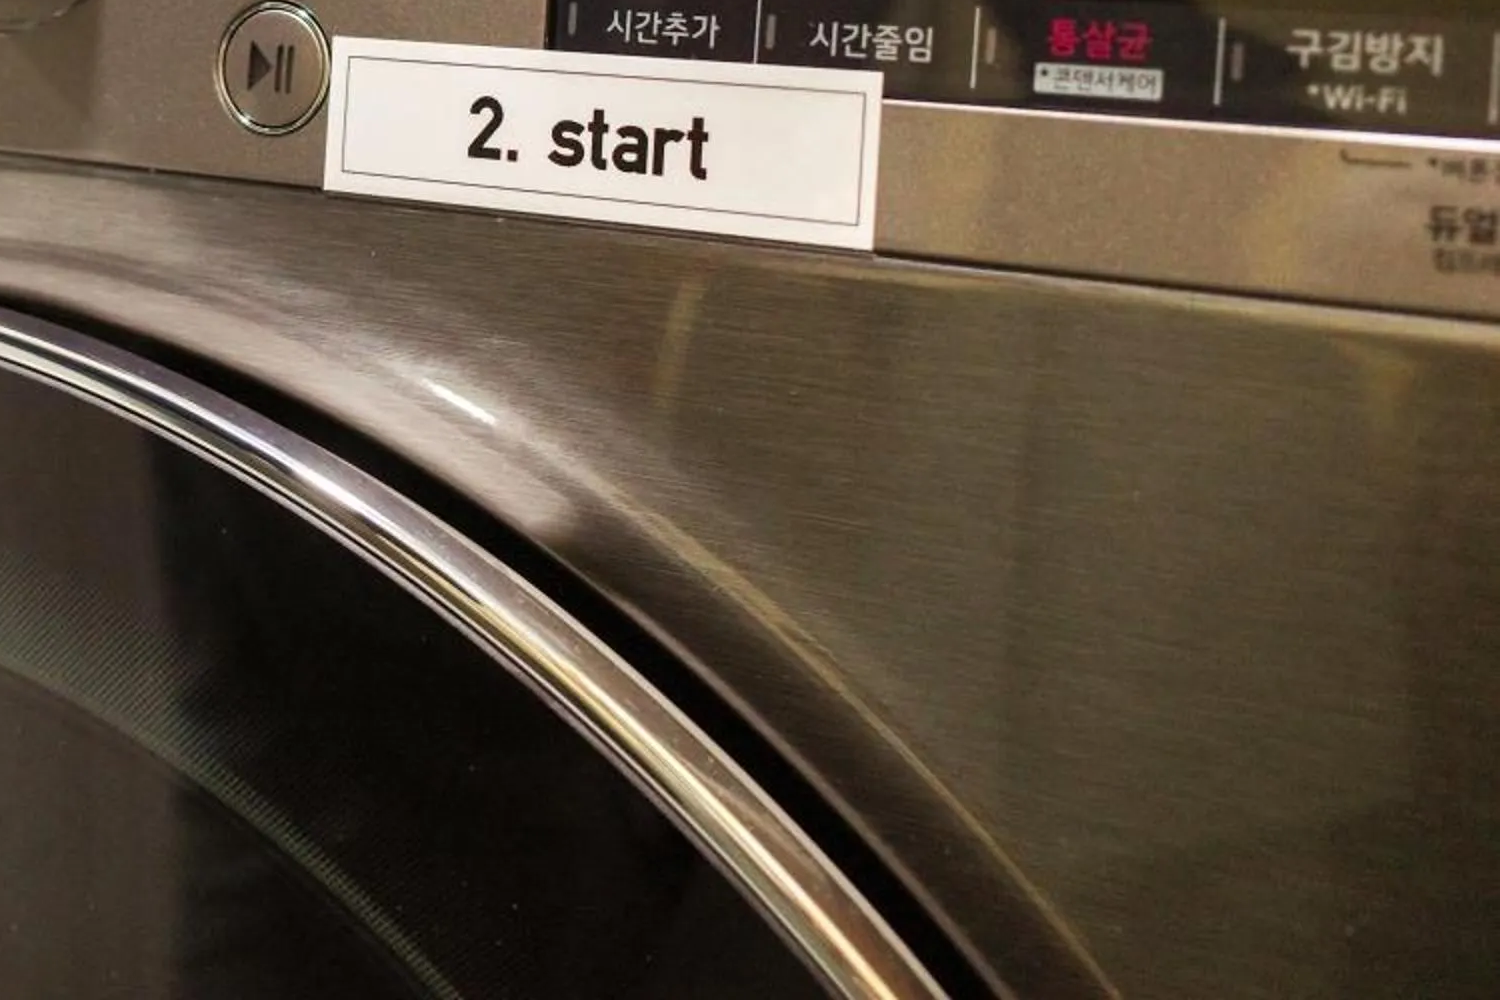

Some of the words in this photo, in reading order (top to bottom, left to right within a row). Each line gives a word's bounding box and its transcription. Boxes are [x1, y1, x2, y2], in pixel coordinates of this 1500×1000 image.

[605, 8, 722, 49] 시간추가
[808, 21, 934, 64] 시간줄임
[1284, 28, 1444, 78] 구김방지
[467, 95, 518, 162] 2.
[547, 108, 709, 180] start
